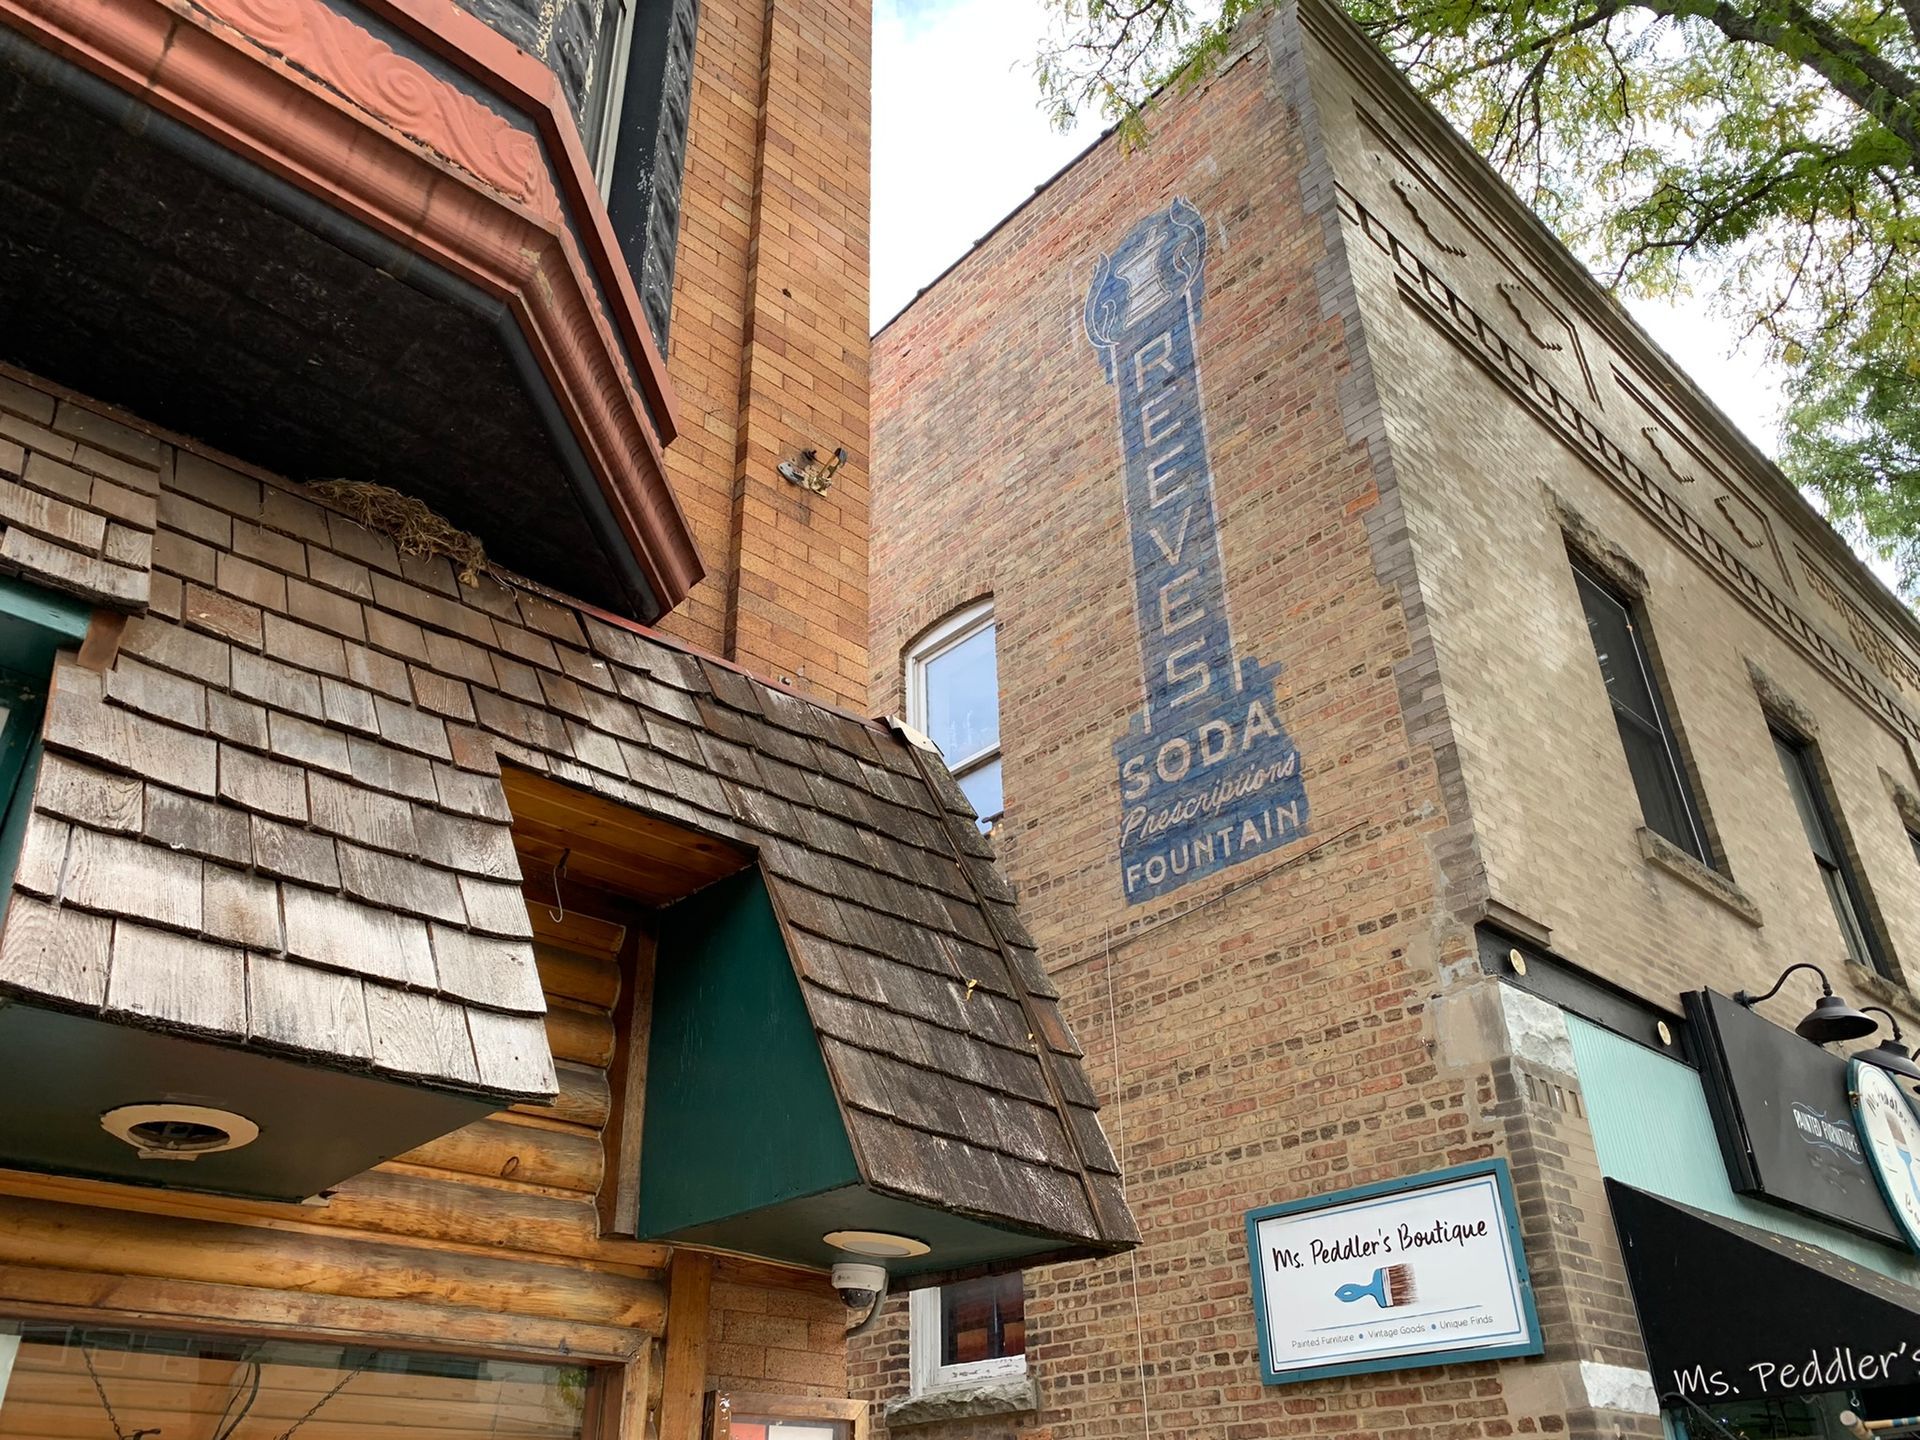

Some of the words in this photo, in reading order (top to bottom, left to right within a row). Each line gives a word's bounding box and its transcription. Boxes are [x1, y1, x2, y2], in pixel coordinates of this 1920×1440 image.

[1134, 331, 1212, 707] REEVES
[1122, 700, 1279, 800] SODA
[1120, 752, 1296, 848] Prescriptions
[1125, 800, 1300, 893] FOUNTAIN
[1272, 1247, 1305, 1272] Ms.
[1310, 1228, 1392, 1265] Peddler's
[1398, 1219, 1488, 1251] Boutique
[1291, 1334, 1320, 1348] Painted
[1321, 1333, 1355, 1346] Furniture
[1368, 1329, 1399, 1339] Vintage
[1400, 1324, 1426, 1335] Goods
[1440, 1318, 1469, 1330] Unique
[1470, 1314, 1494, 1325] Finds
[1673, 1364, 1740, 1396] Ms.
